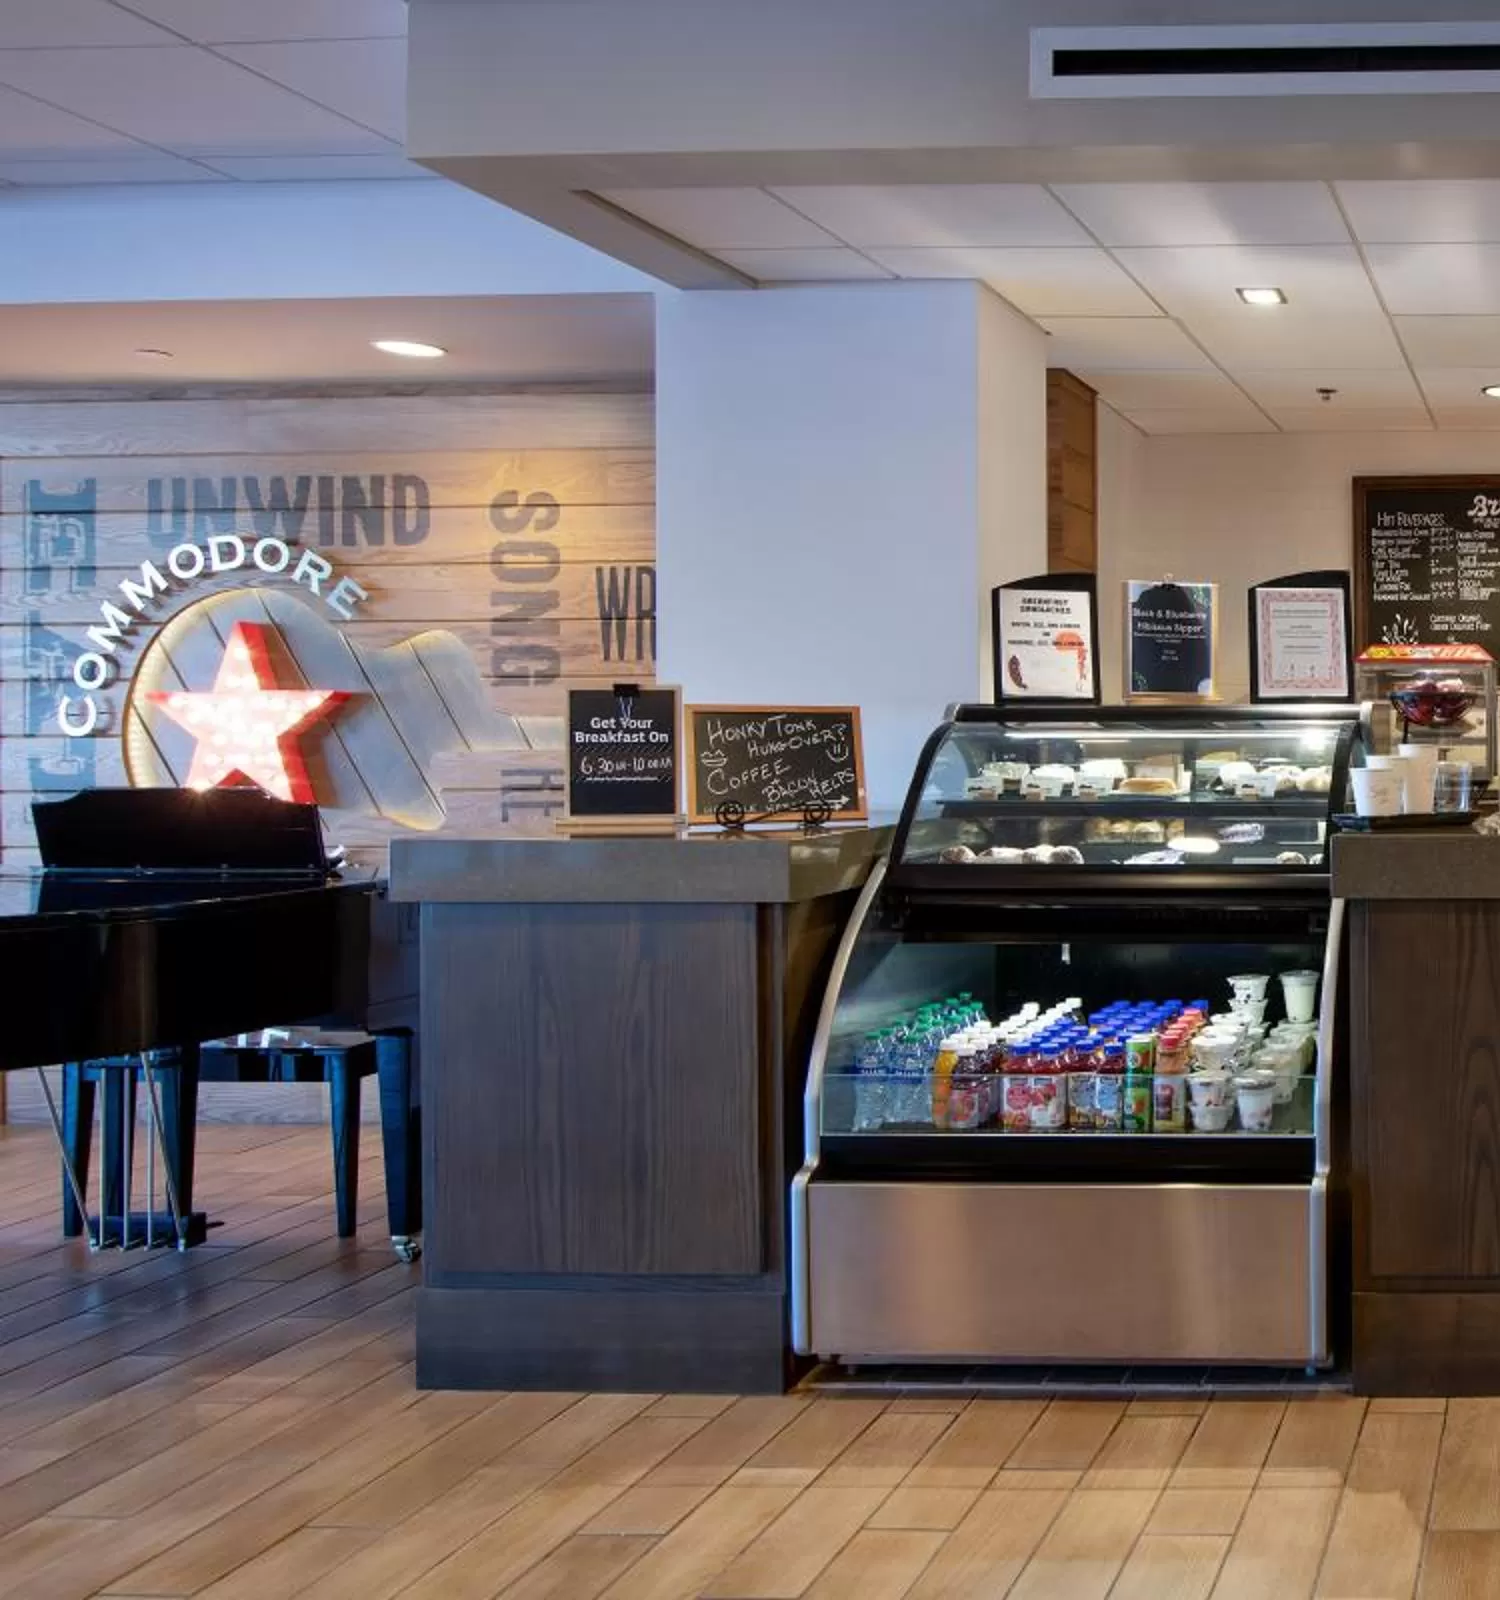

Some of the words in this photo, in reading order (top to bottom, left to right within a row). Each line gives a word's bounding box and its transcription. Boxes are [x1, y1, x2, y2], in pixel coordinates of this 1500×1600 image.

[147, 475, 431, 547] UNWIND
[488, 489, 562, 687] SONG
[58, 535, 369, 737] COMMODORE
[575, 730, 646, 743] Breakfast
[649, 731, 670, 743] On
[590, 717, 616, 729] Get
[620, 717, 654, 729] Your
[707, 719, 767, 749] HONKY
[707, 758, 791, 796] COFFEE
